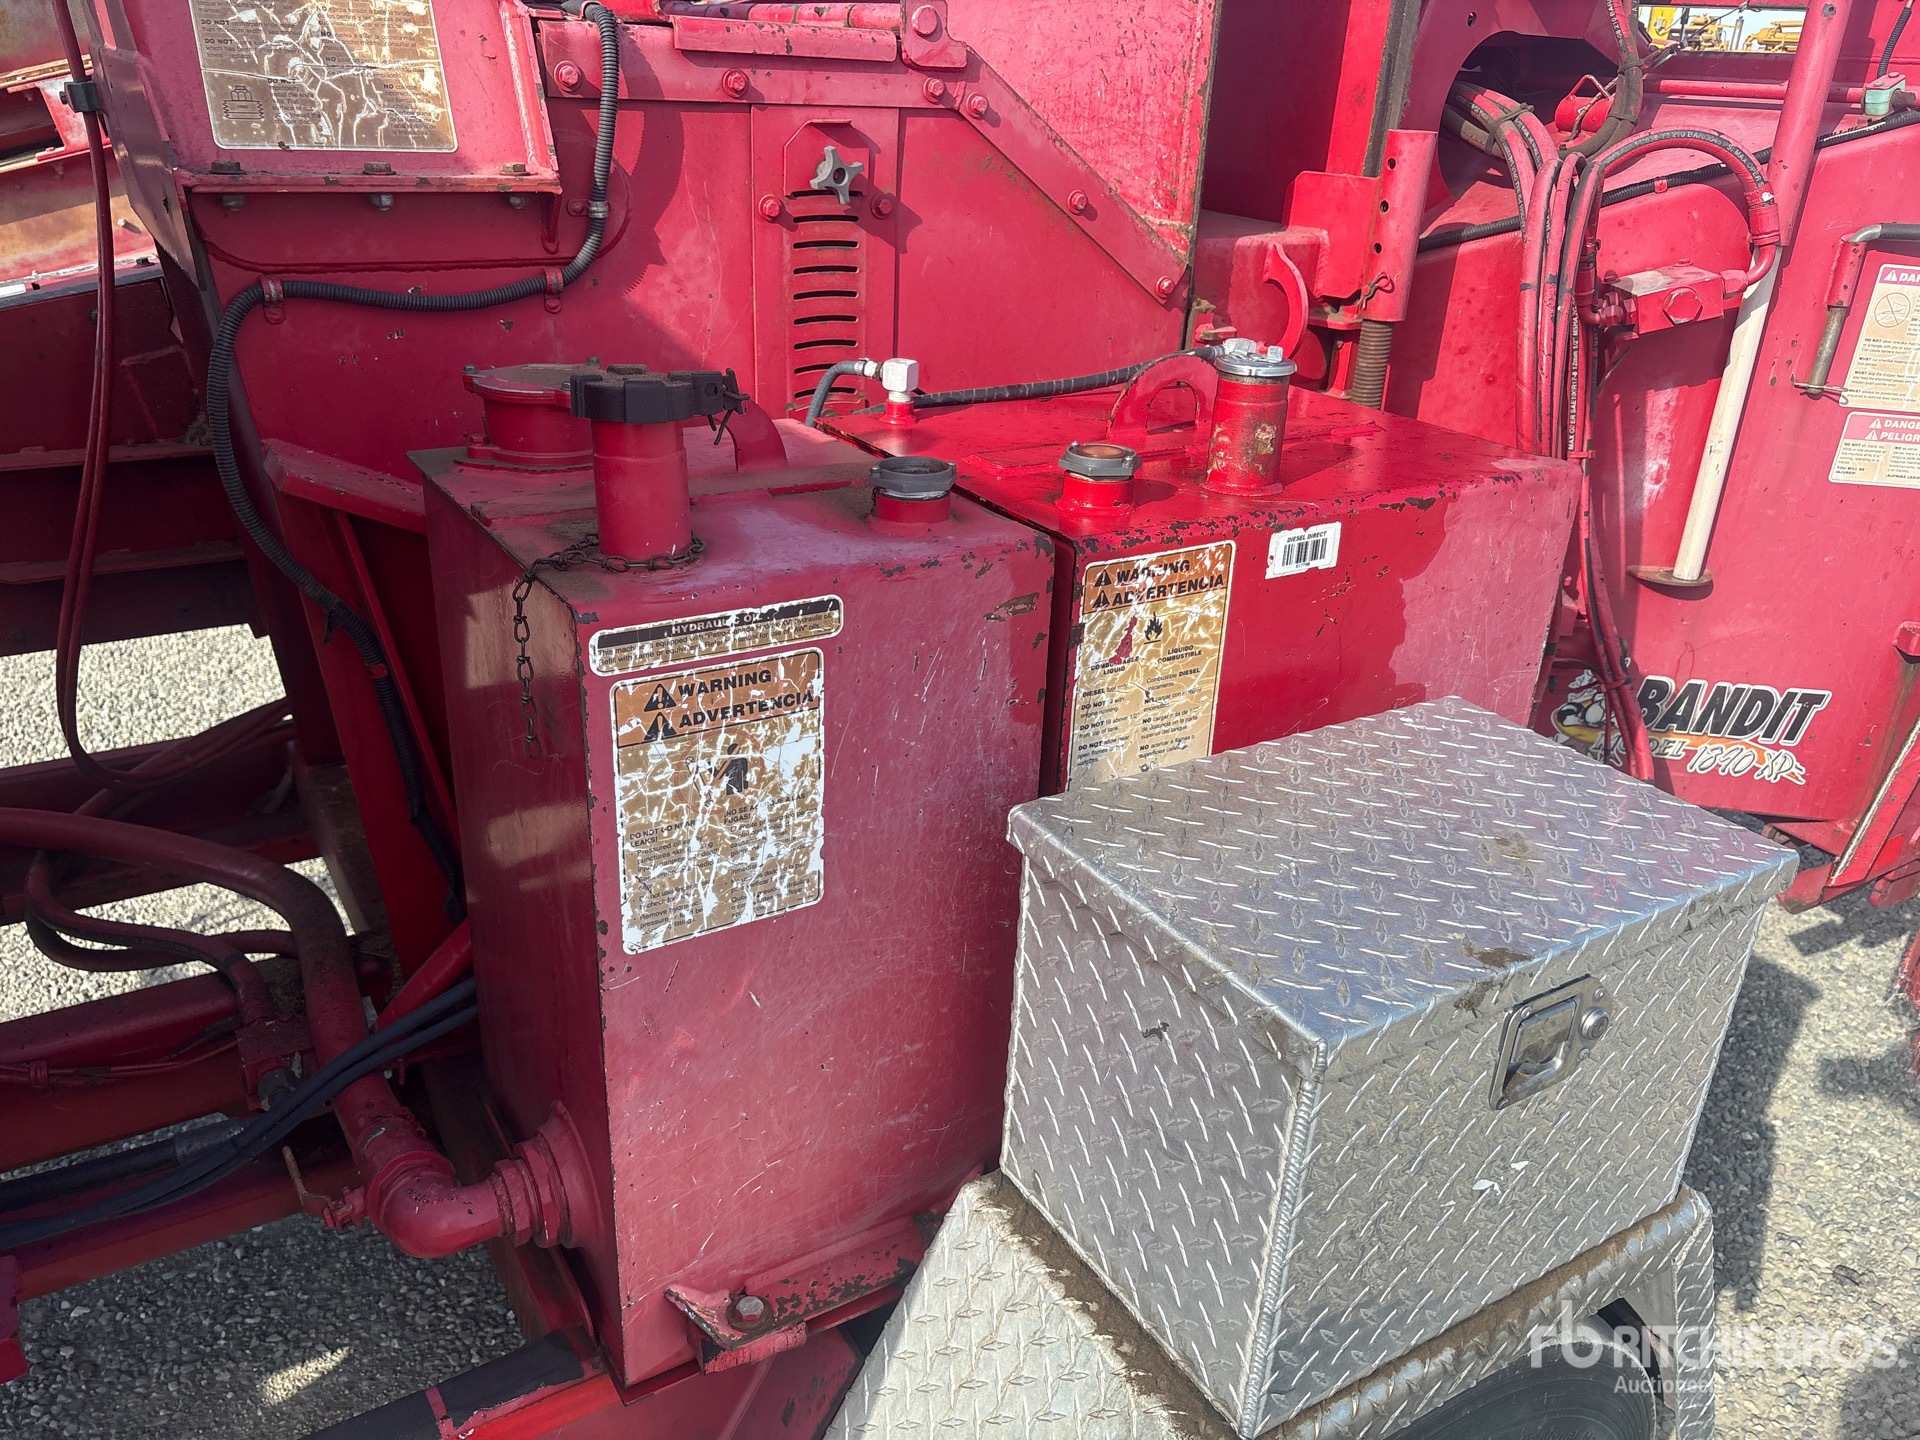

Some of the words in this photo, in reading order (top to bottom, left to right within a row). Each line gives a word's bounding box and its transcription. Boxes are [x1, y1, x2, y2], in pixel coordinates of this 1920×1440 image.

[1287, 535, 1306, 543] DIESEL
[1307, 531, 1328, 540] DIRECT
[1179, 668, 1200, 677] DIESEL
[678, 669, 772, 697] WARNING
[1083, 688, 1105, 697] DIESEL
[679, 690, 814, 729] ADVERTENCIA
[1093, 700, 1106, 708] NOT
[1637, 677, 1831, 744] BANDIT
[724, 814, 751, 824] FUGAS!
[630, 832, 641, 840] DO
[643, 829, 658, 837] NOT
[630, 836, 658, 847] LEAKS!
